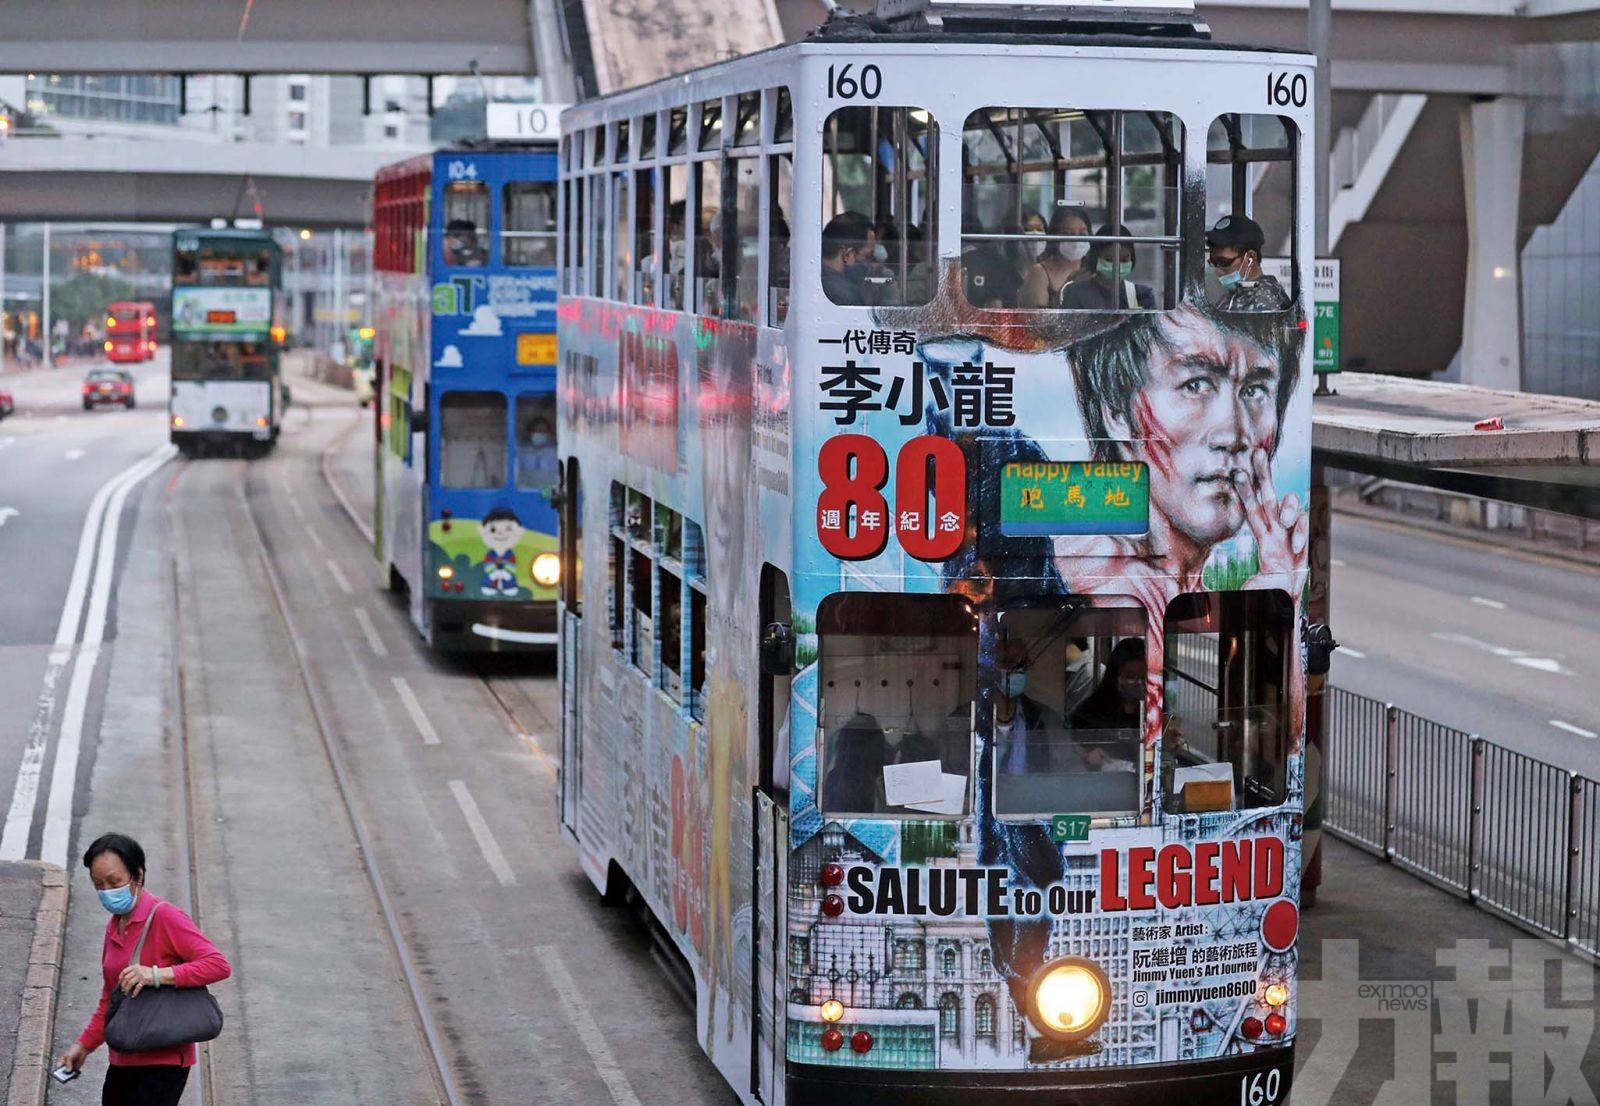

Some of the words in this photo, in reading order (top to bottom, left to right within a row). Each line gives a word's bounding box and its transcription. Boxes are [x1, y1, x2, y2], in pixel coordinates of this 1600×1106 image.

[827, 64, 882, 99] 160
[1267, 72, 1307, 107] 160
[818, 329, 918, 355] 一代傳奇
[818, 361, 1016, 427] 李小龍
[1006, 462, 1071, 483] Happy
[1081, 462, 1143, 483] Valley
[817, 434, 967, 561] 80
[821, 508, 960, 532] 週年紀念
[1055, 820, 1088, 838] S17
[847, 867, 1010, 917] SALUTE
[1014, 887, 1040, 916] to
[1048, 885, 1096, 915] Our
[1100, 836, 1285, 912] LEGEND
[1132, 925, 1172, 942] 藝術家
[1132, 946, 1187, 969] 阮繼增
[1192, 942, 1258, 964] 的藝術旅程
[1132, 969, 1167, 983] Jimmy
[1205, 965, 1220, 977] Art
[1221, 960, 1258, 975] Journey
[1155, 980, 1257, 1006] jimmyyuen8600
[1241, 1067, 1281, 1105] 160
